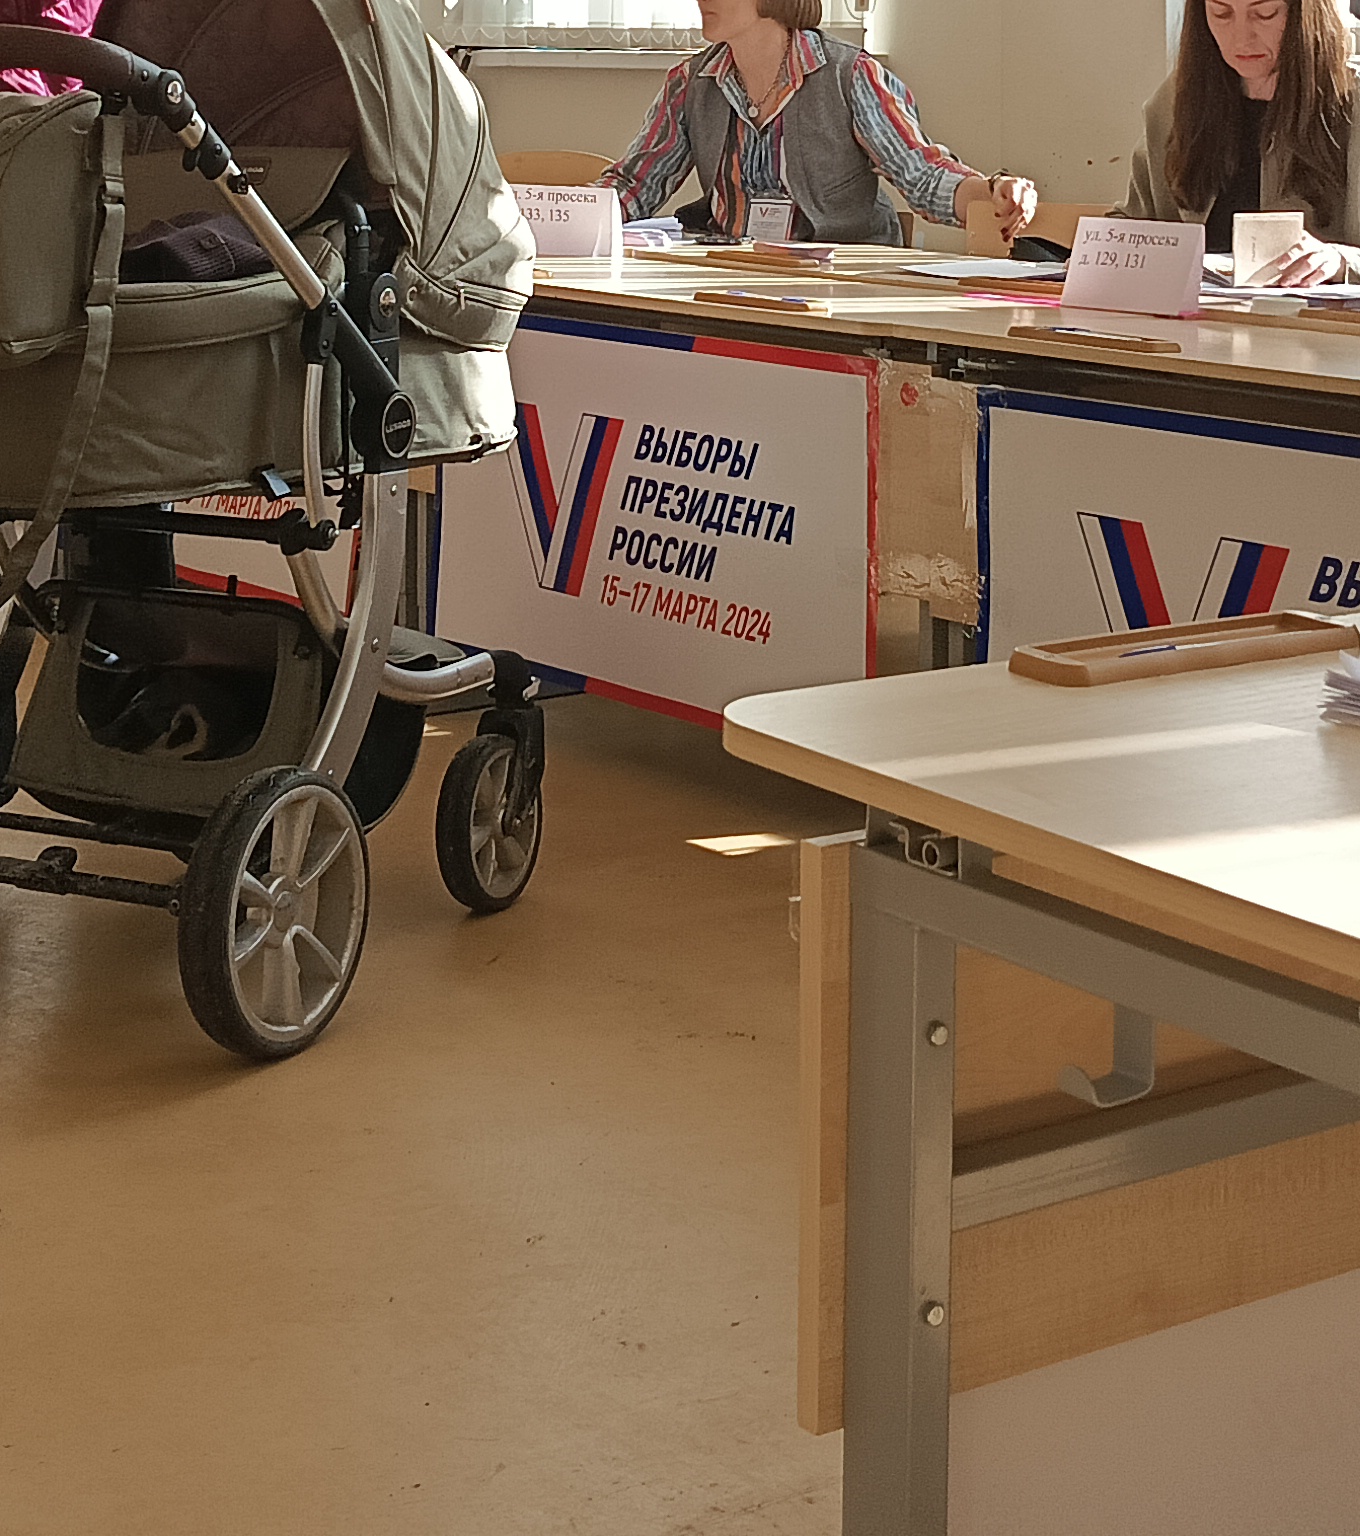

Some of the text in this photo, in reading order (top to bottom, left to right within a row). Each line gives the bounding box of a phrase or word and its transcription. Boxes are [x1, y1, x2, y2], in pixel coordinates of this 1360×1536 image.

[547, 191, 597, 205] просека
[549, 209, 570, 222] 135
[1106, 228, 1125, 243] 5-я
[1128, 233, 1179, 248] просека
[1124, 252, 1146, 269] 131
[633, 423, 760, 480] ВЫБОРЫ
[619, 474, 796, 546] ПРЕЗИДЕНТА
[608, 525, 718, 583] РОССИИ
[651, 585, 719, 632] МАРТА
[720, 602, 771, 644] 2024
